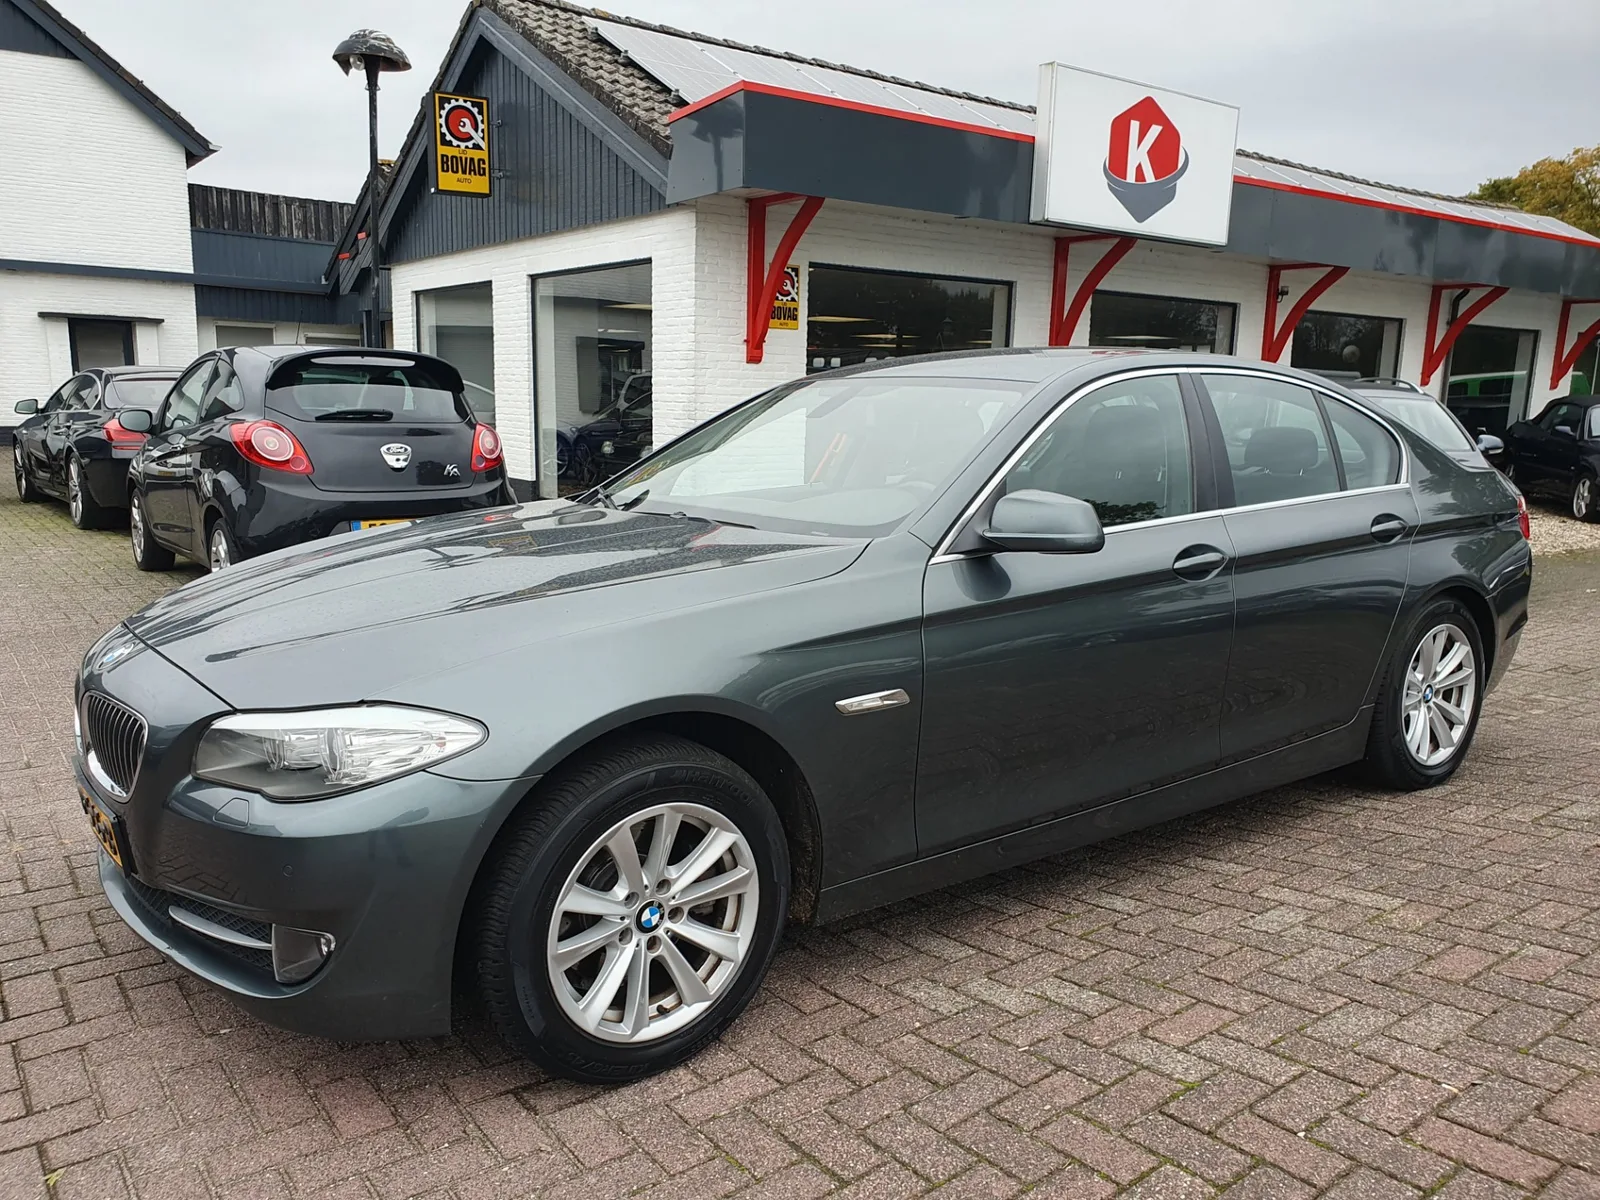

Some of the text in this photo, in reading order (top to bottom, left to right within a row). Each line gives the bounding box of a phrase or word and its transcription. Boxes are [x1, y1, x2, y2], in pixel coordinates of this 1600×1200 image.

[1126, 119, 1163, 183] K
[440, 153, 487, 177] BOVAG
[770, 305, 798, 321] BOVAG
